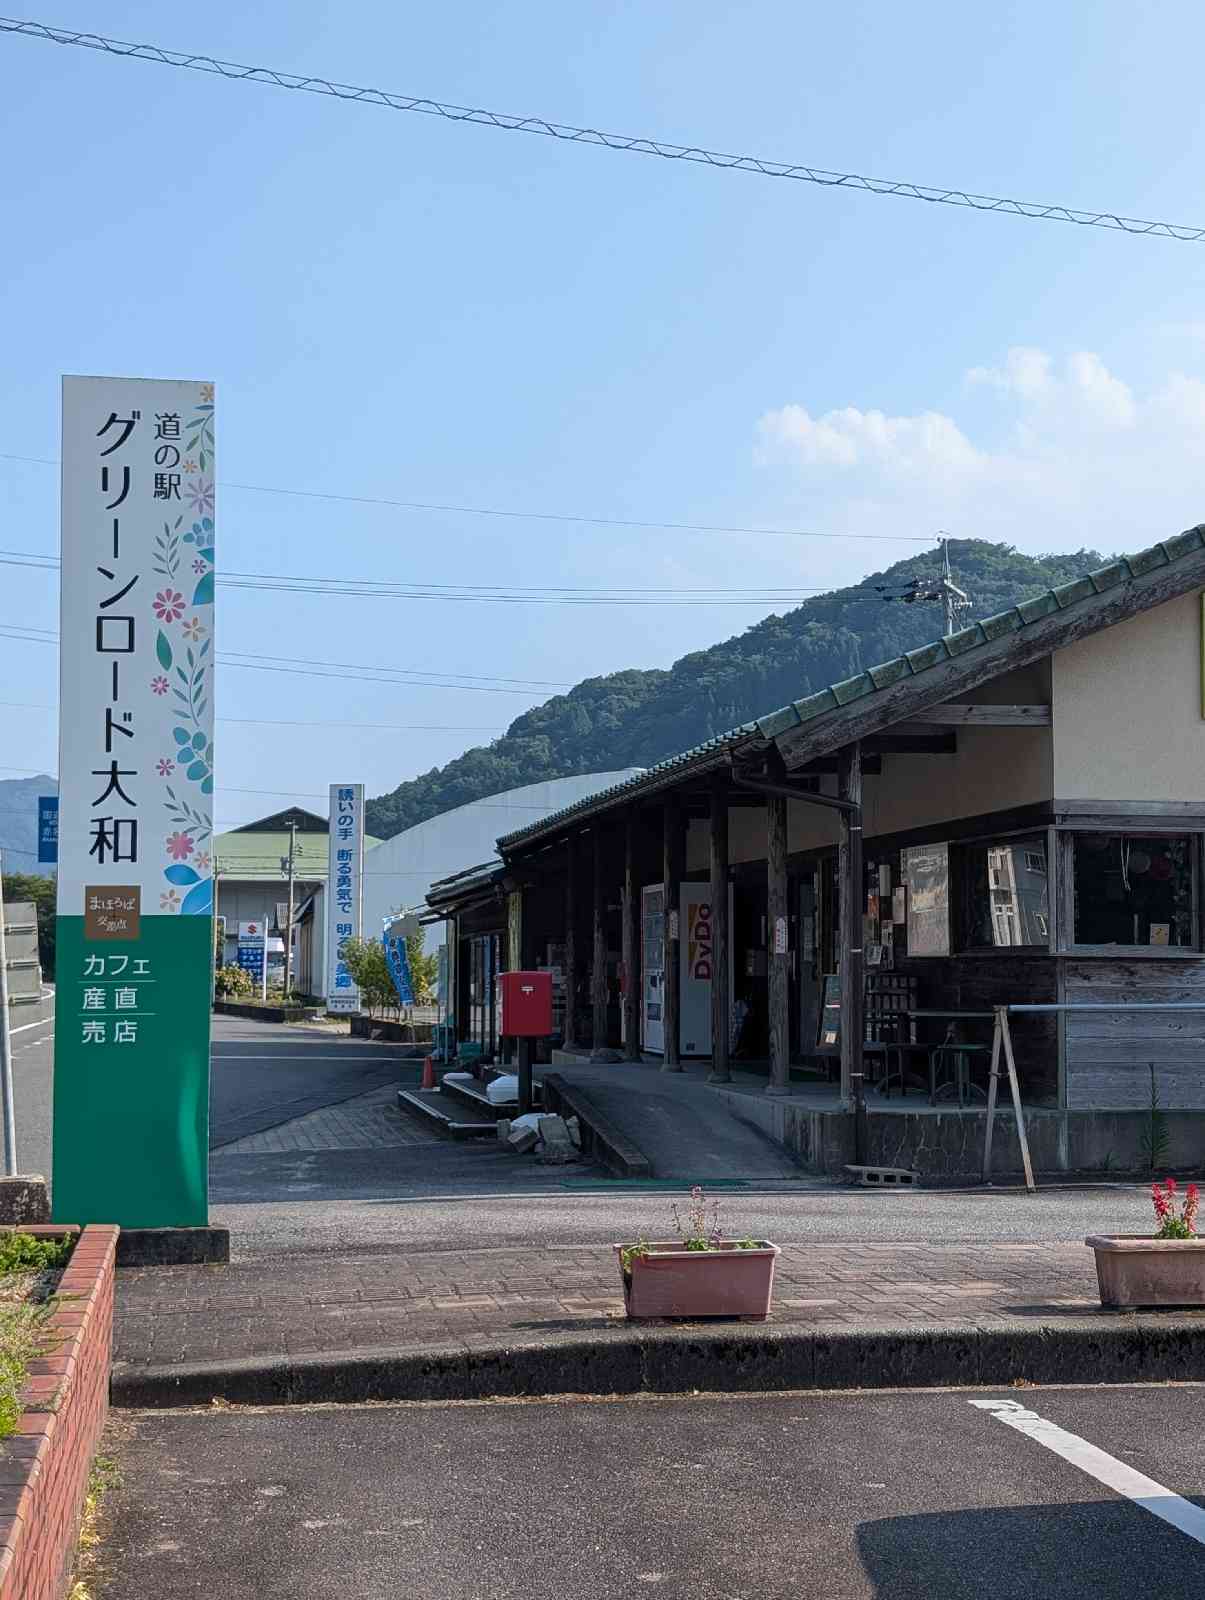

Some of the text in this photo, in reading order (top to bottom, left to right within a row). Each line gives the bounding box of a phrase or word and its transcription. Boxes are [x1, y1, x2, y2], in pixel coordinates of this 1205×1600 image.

[153, 412, 182, 500] 道の駅
[90, 411, 141, 864] グリーンロード大和
[83, 954, 151, 976] カフェ
[82, 986, 138, 1010] 産直
[81, 1019, 137, 1044] 売店
